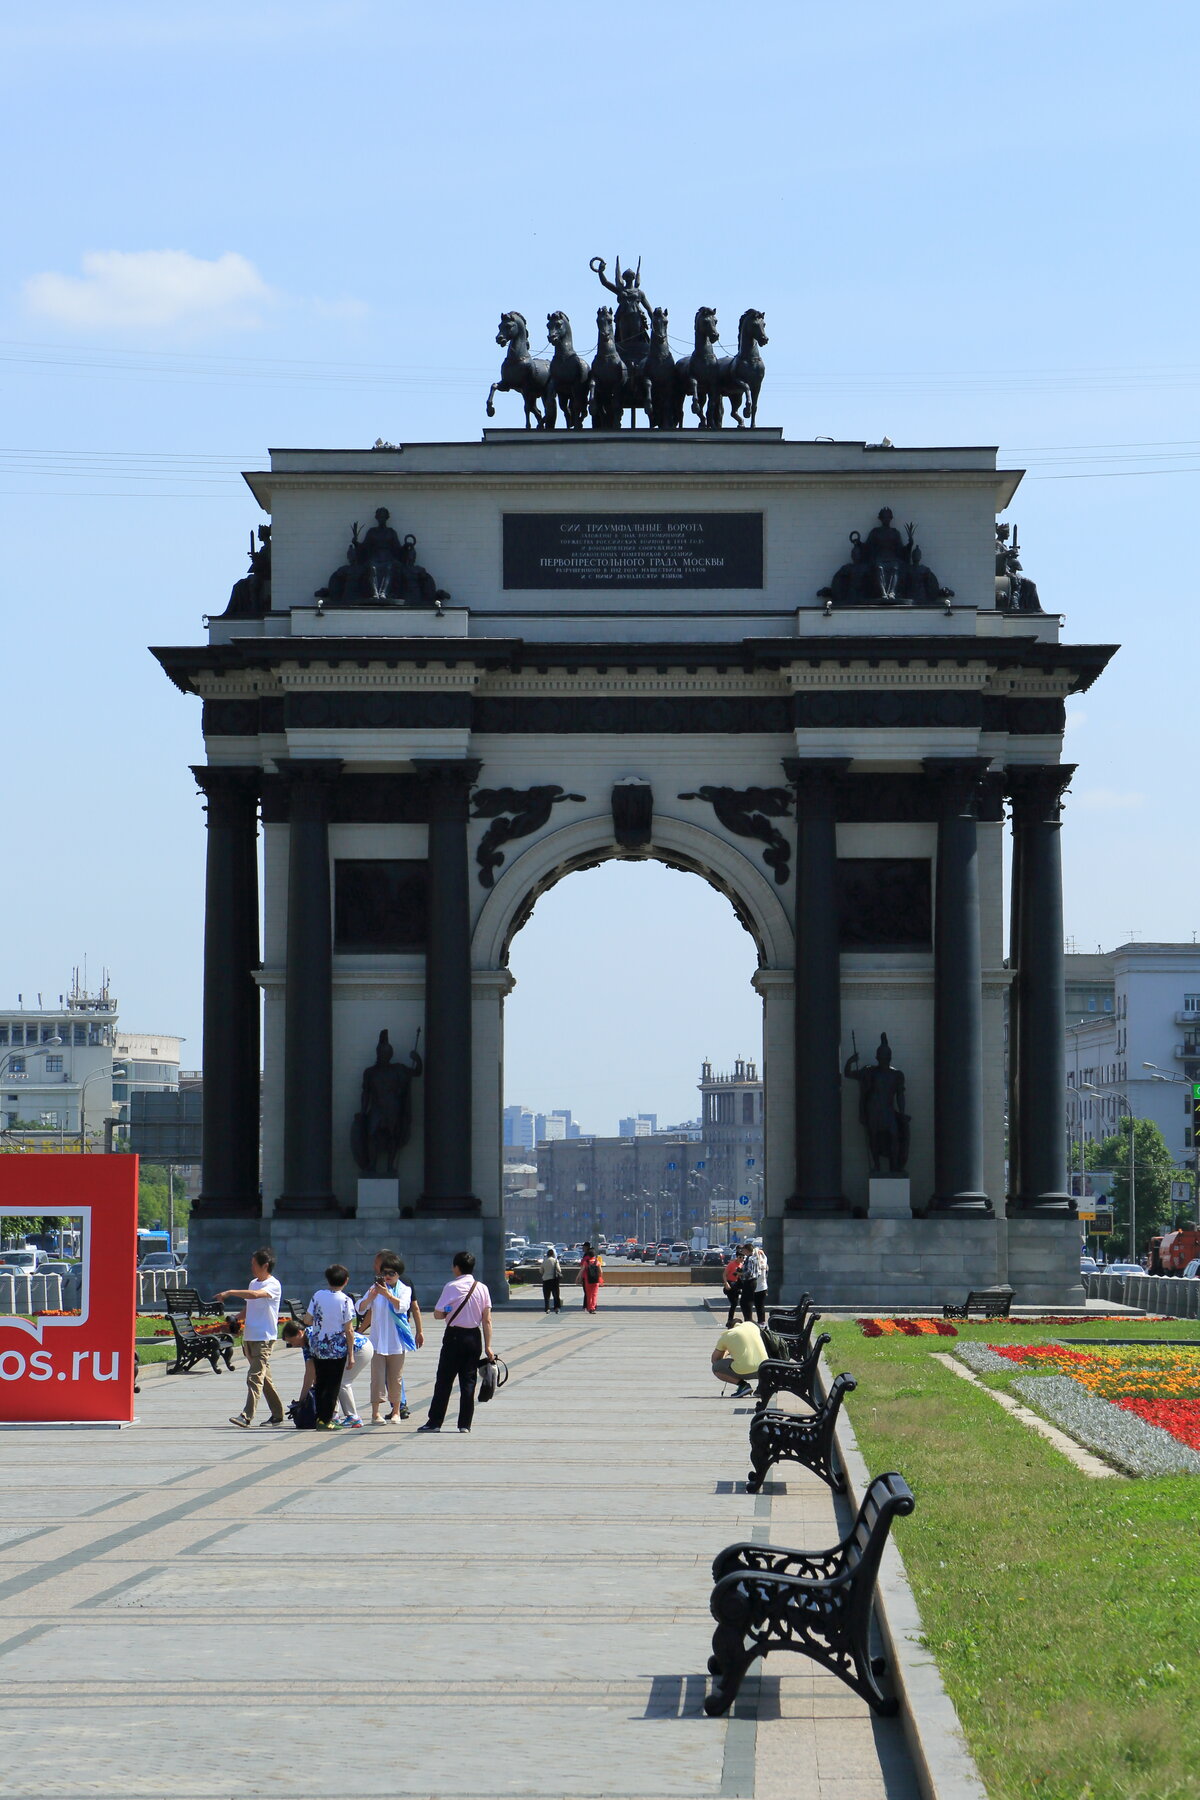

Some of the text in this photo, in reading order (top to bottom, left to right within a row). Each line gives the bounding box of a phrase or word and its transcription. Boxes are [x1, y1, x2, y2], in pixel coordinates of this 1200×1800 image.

[560, 523, 703, 532] СИИ ТРИУМФАЛЬНЫЕ ВОРОТА
[540, 557, 724, 567] ПЕРВОПРЕСТОЛЬНОГО ГРАДА МОСКВЫ
